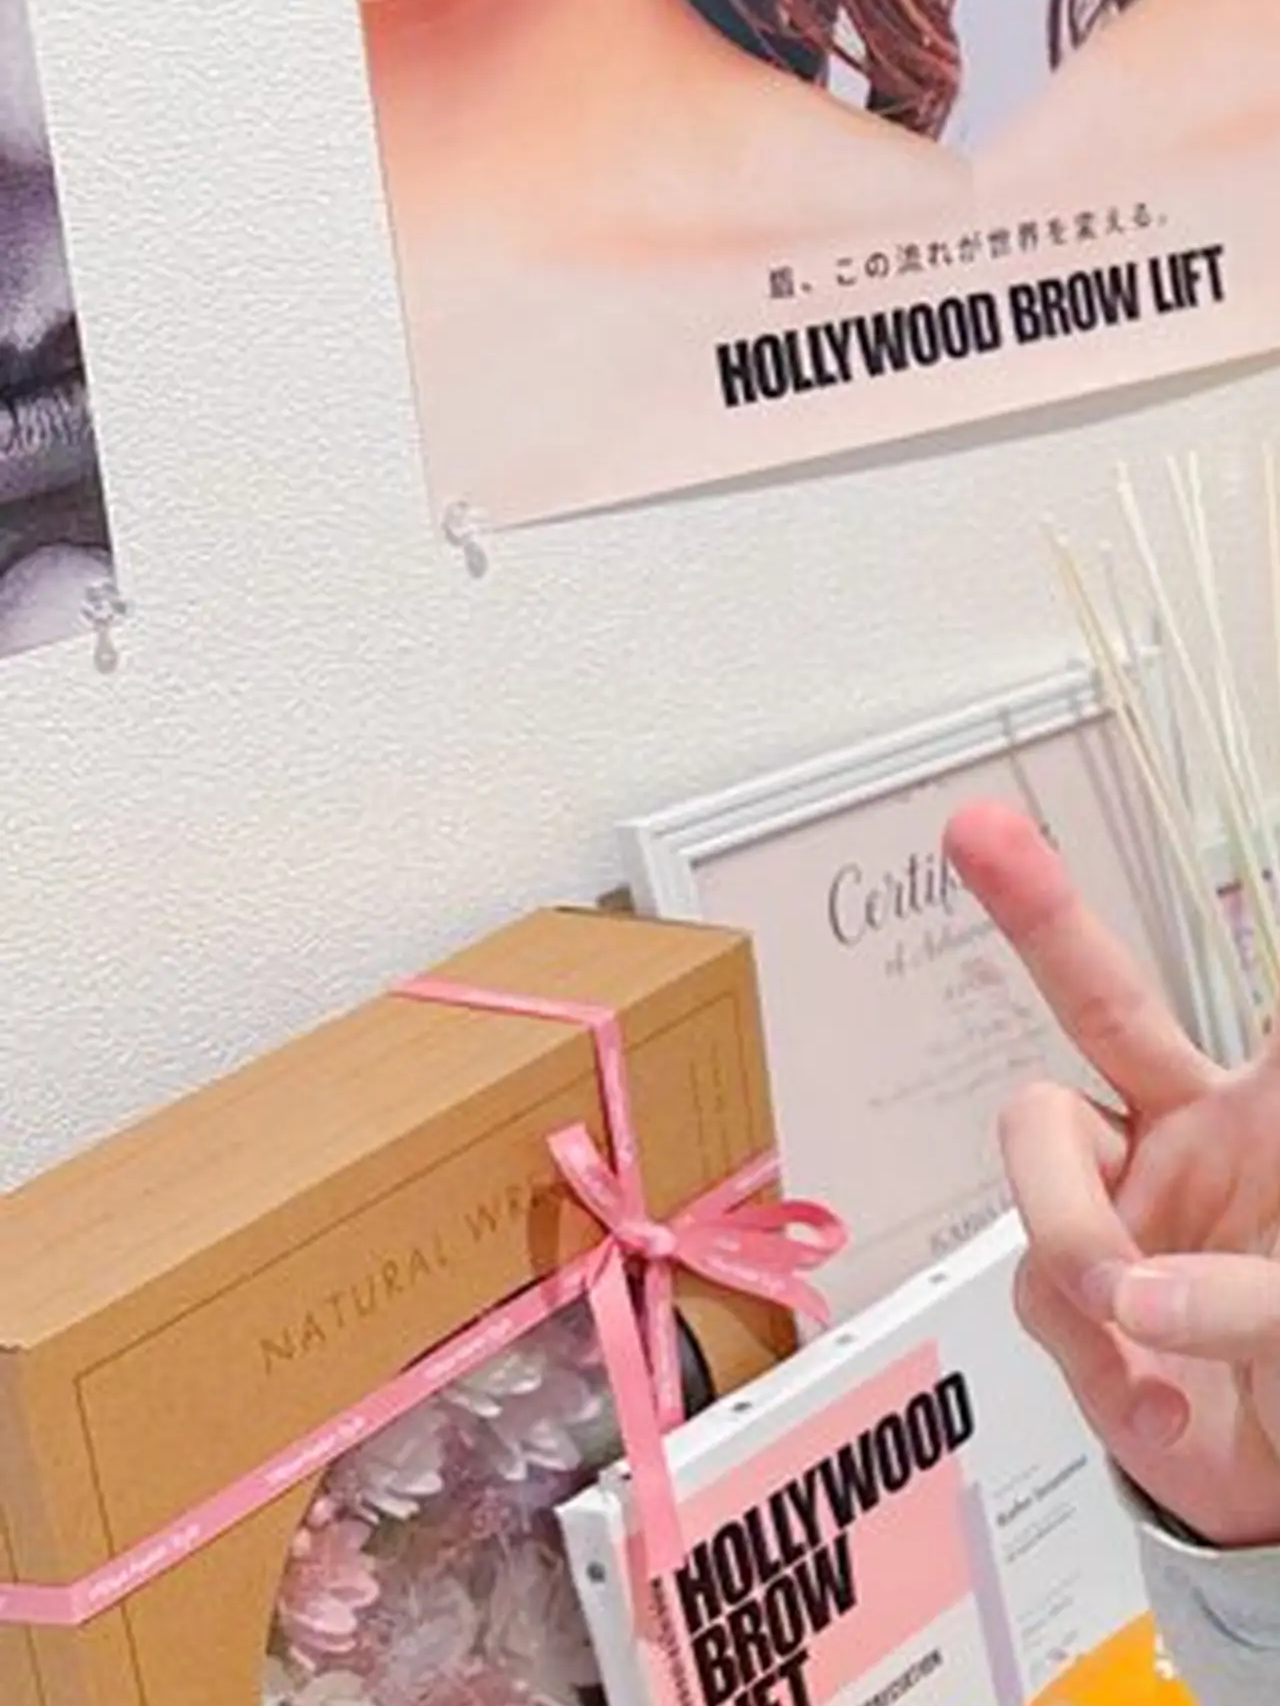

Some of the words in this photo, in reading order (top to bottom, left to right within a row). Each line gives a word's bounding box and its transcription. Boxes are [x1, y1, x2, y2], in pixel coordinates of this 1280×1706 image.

[716, 292, 1001, 408] HOLLYWOOD
[1008, 261, 1141, 346] BROW
[1148, 244, 1227, 314] LIFT
[258, 1231, 449, 1374] NATURAL
[674, 1371, 975, 1635] HOLLYWOOD
